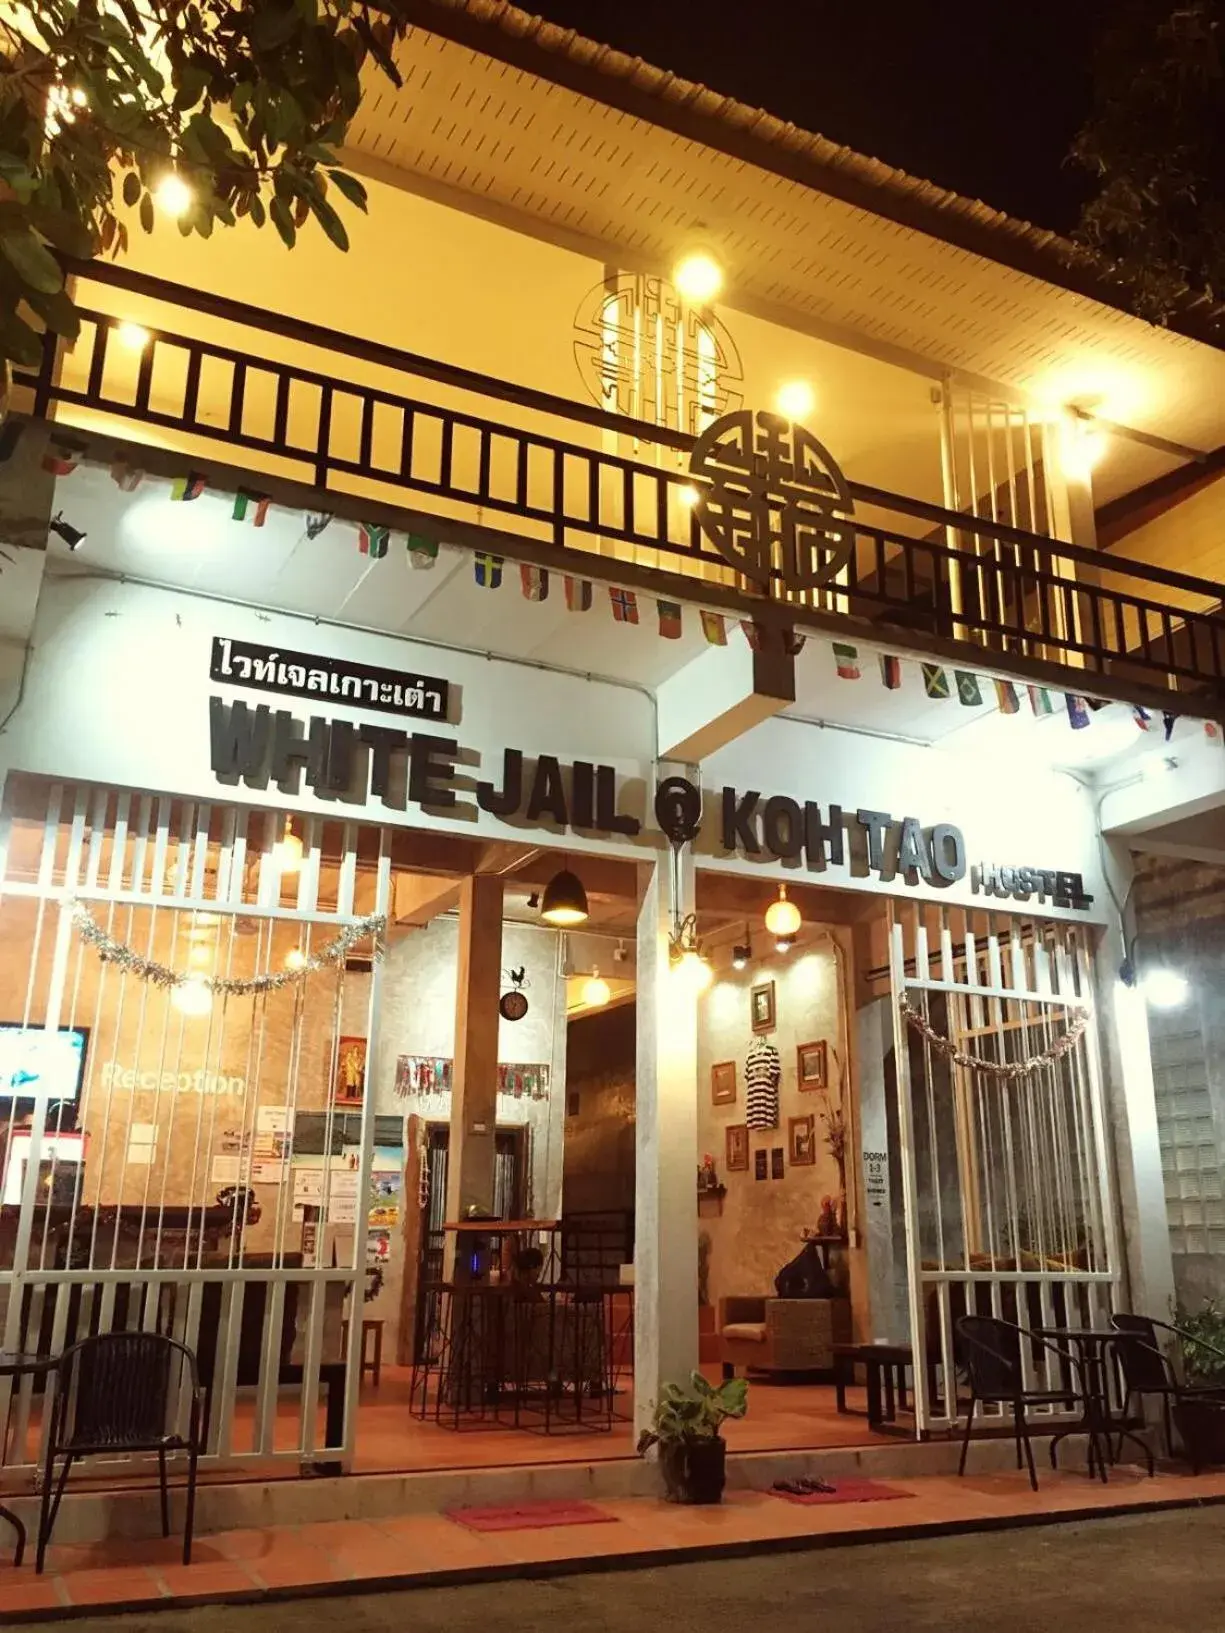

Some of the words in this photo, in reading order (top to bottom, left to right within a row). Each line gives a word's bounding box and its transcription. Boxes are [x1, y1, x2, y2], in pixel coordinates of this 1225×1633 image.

[219, 638, 441, 713] ไวท์เจลเกาะเต่า
[208, 695, 458, 807] WHITE
[476, 748, 641, 836] JAIL
[723, 786, 844, 866] KOH
[856, 808, 967, 882] TAO
[979, 860, 1094, 905] HOSTEL
[101, 1061, 246, 1096] Reception
[863, 1151, 887, 1162] DORM
